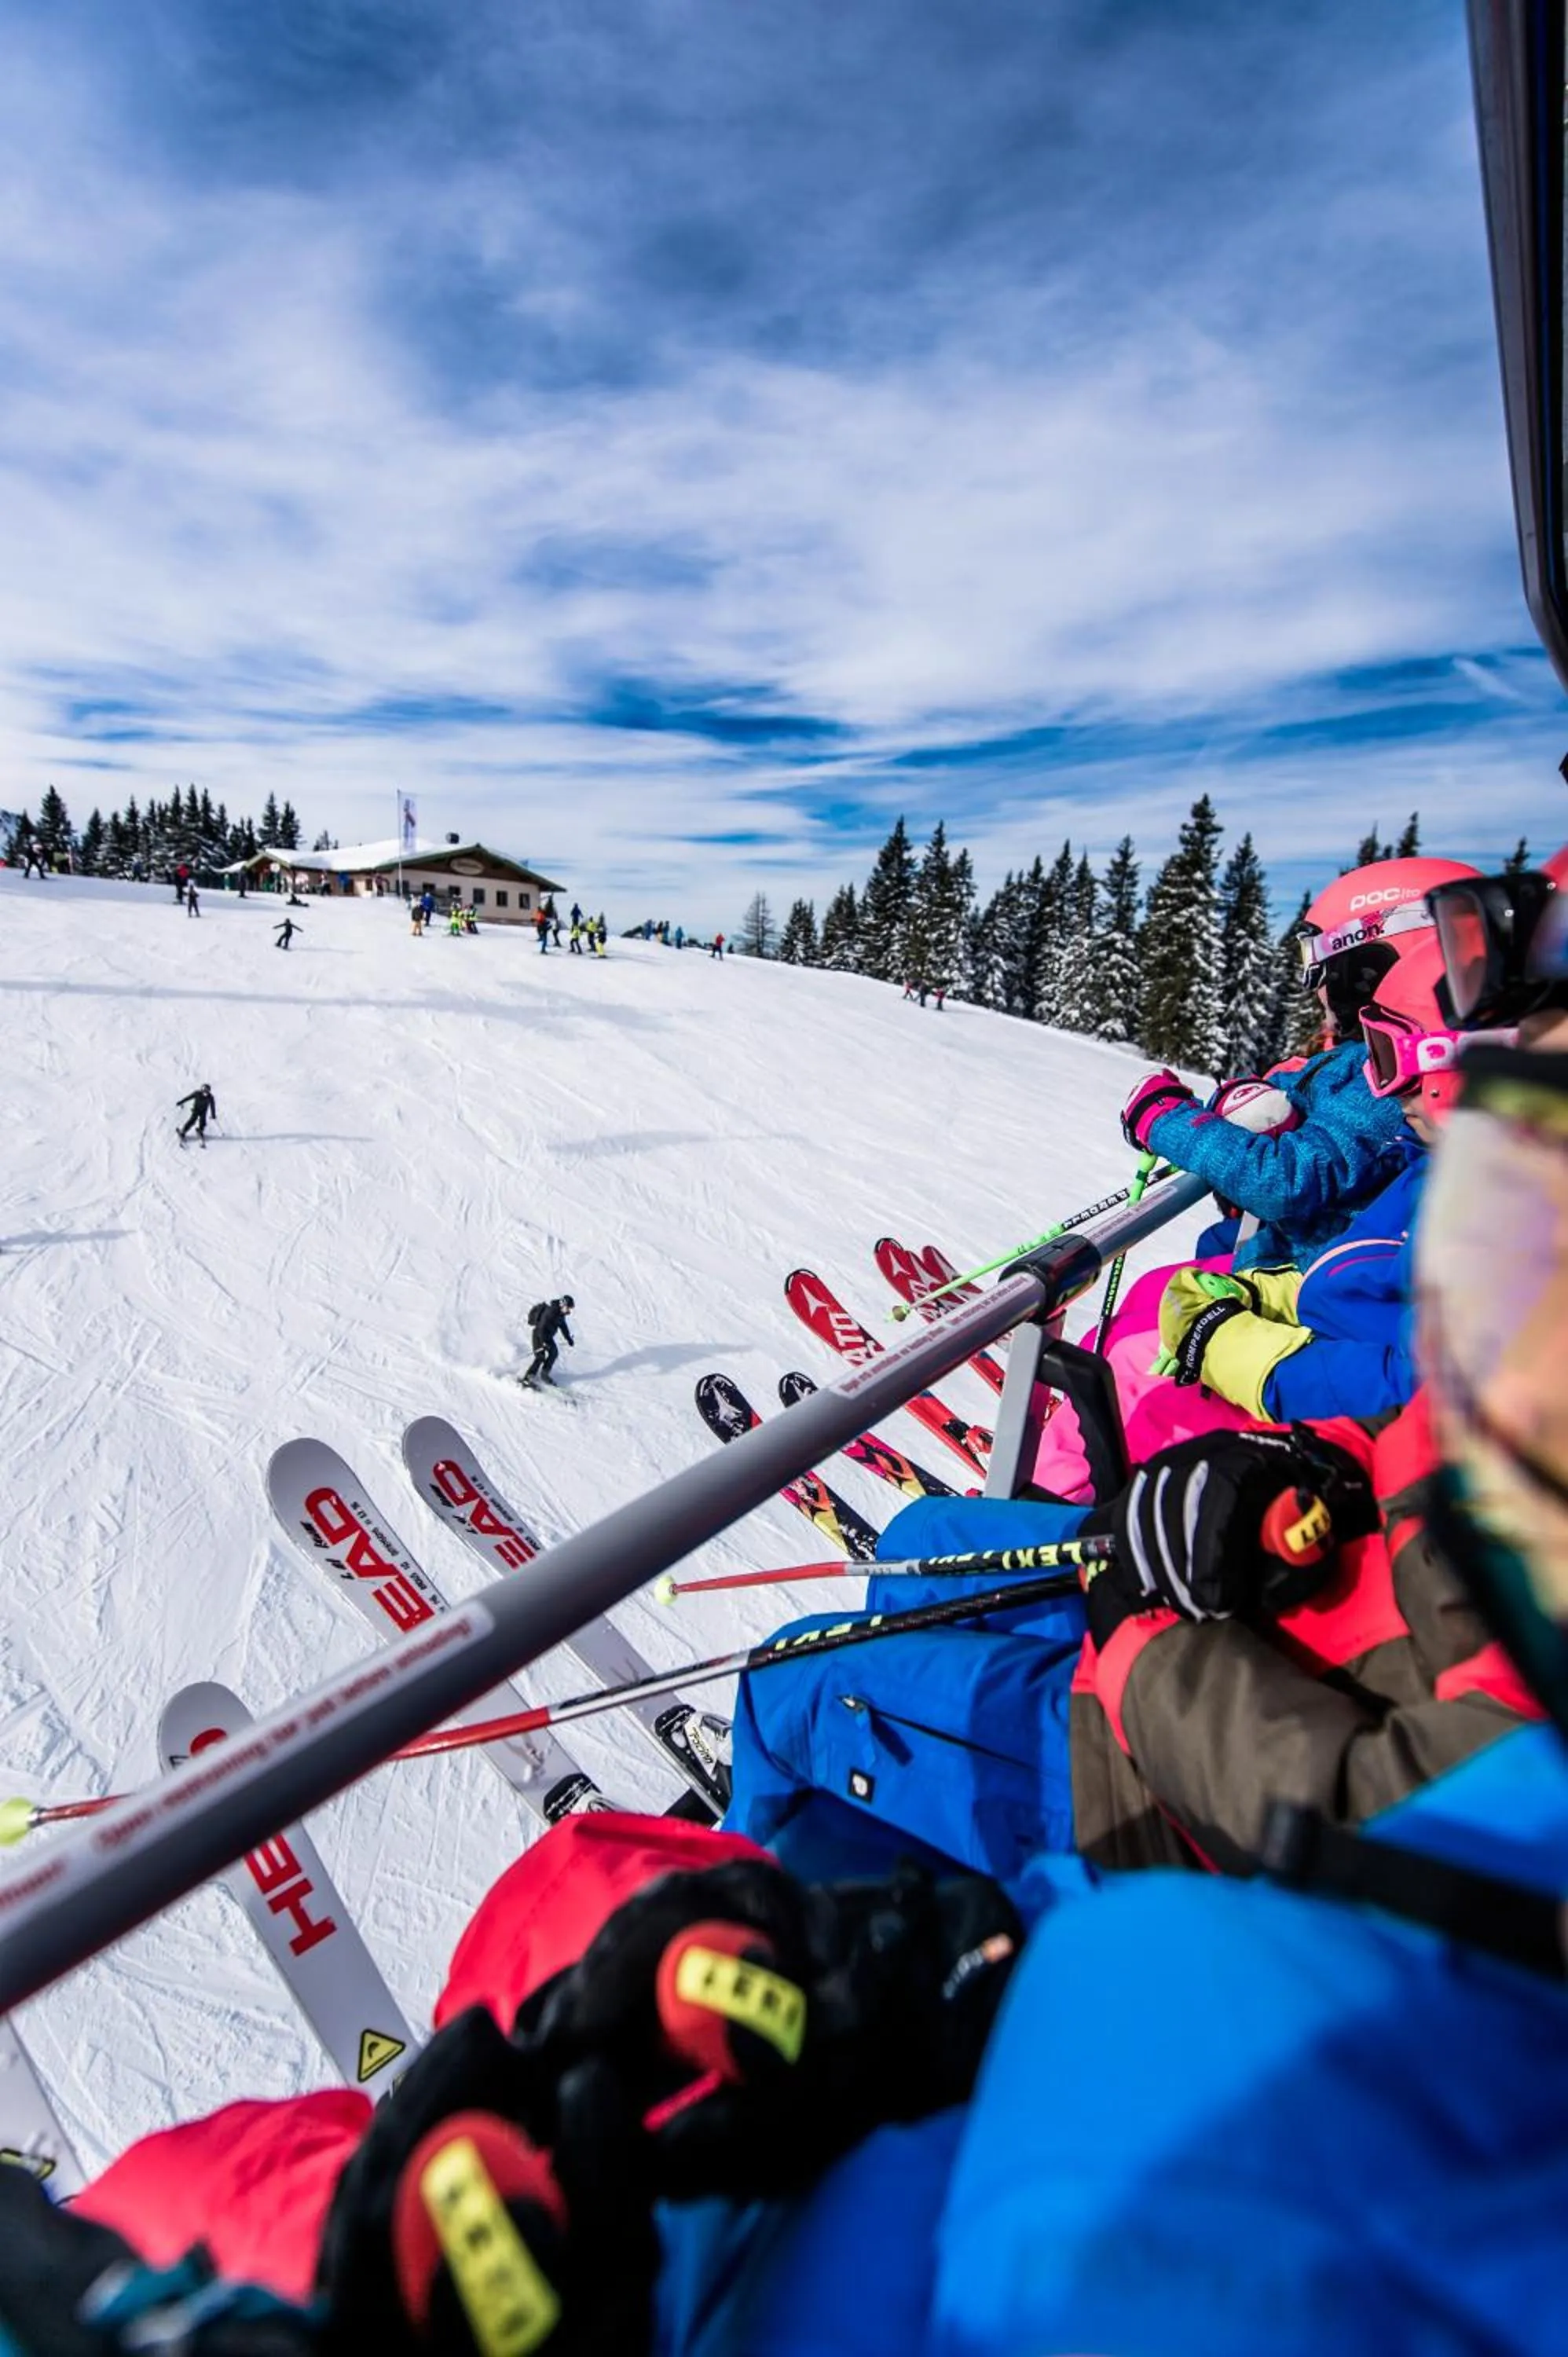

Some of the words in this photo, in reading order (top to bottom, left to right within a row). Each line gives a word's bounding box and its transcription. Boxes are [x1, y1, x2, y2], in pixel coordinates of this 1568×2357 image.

[305, 1486, 435, 1633] EAD
[432, 1459, 536, 1571] EAD
[1001, 1541, 1083, 1571] LEKI
